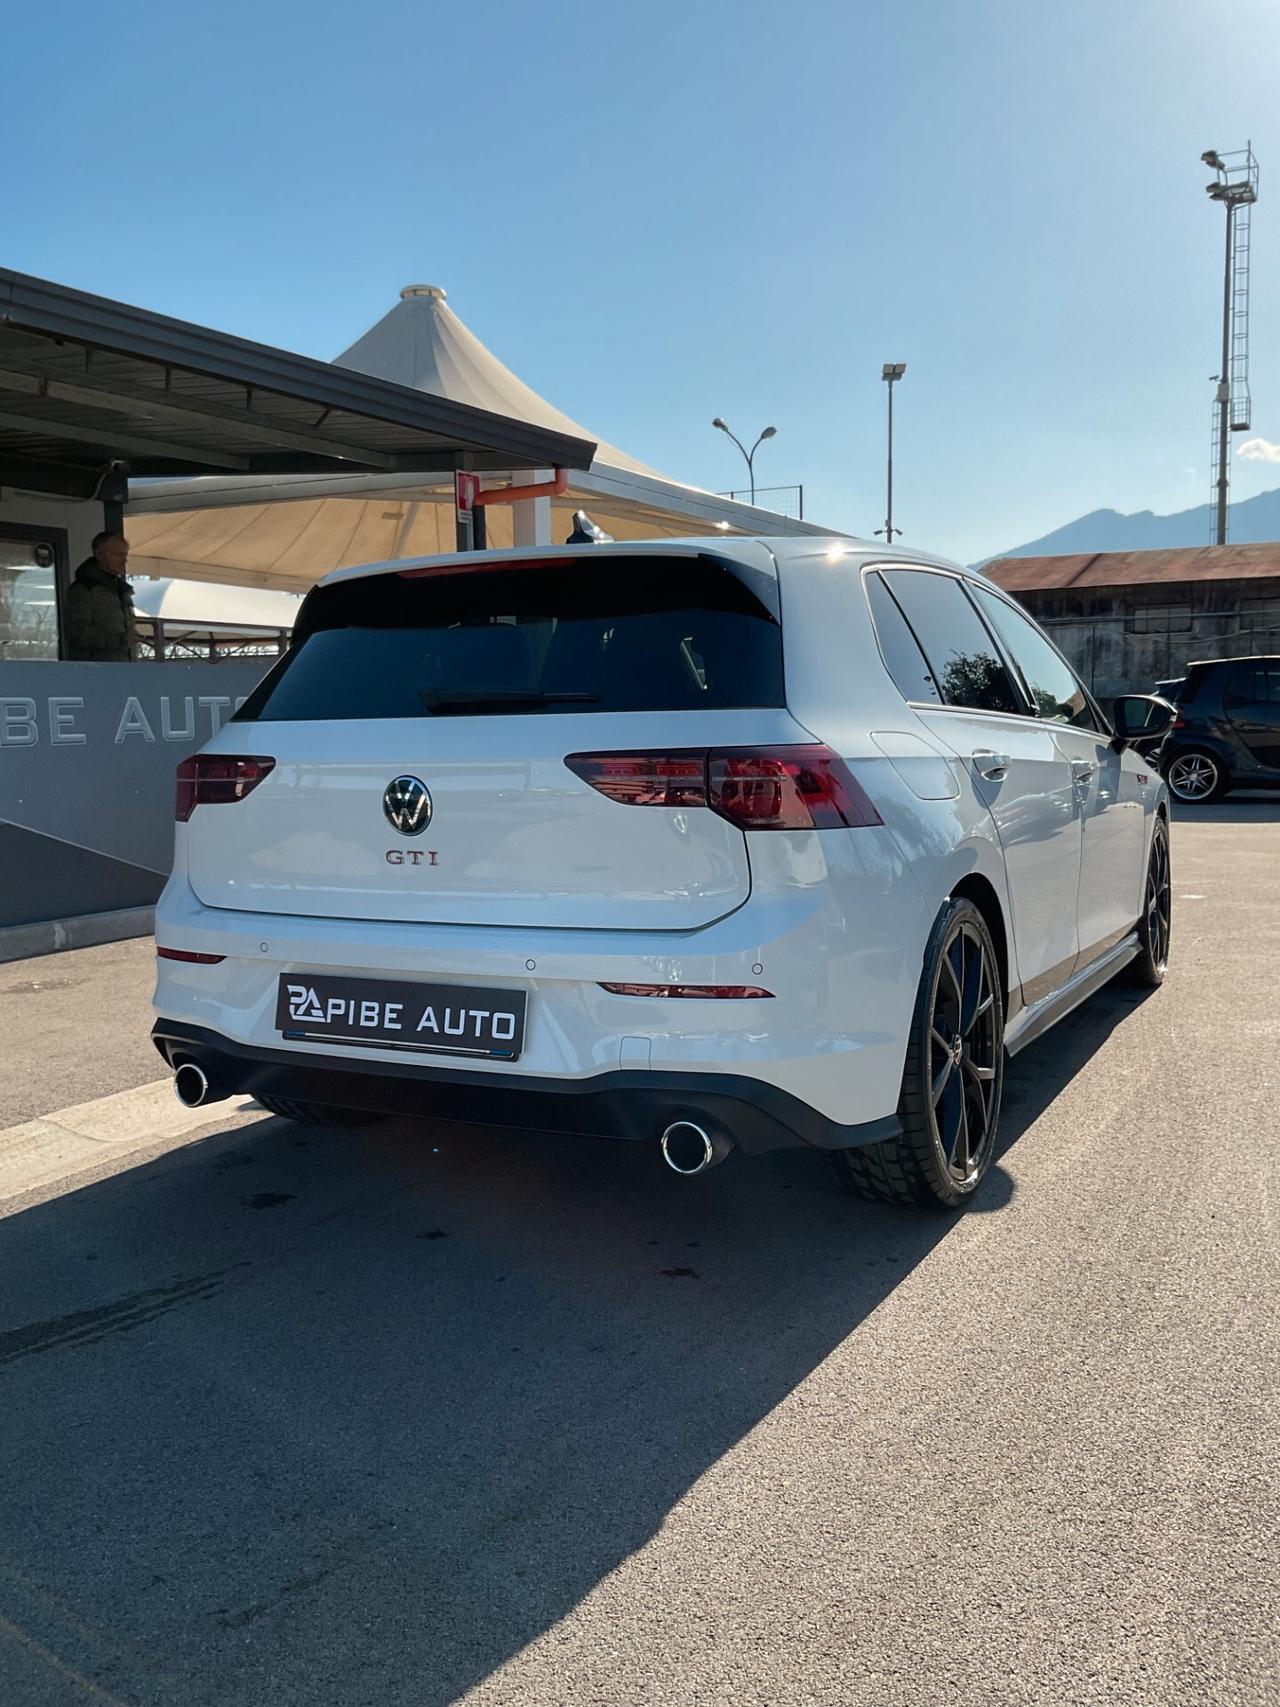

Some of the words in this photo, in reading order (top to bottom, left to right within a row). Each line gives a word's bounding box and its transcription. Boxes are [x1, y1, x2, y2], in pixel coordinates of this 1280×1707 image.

[384, 777, 431, 833] VW
[385, 849, 439, 866] GTI
[325, 998, 404, 1030] PIBE
[416, 1006, 516, 1041] AUTO
